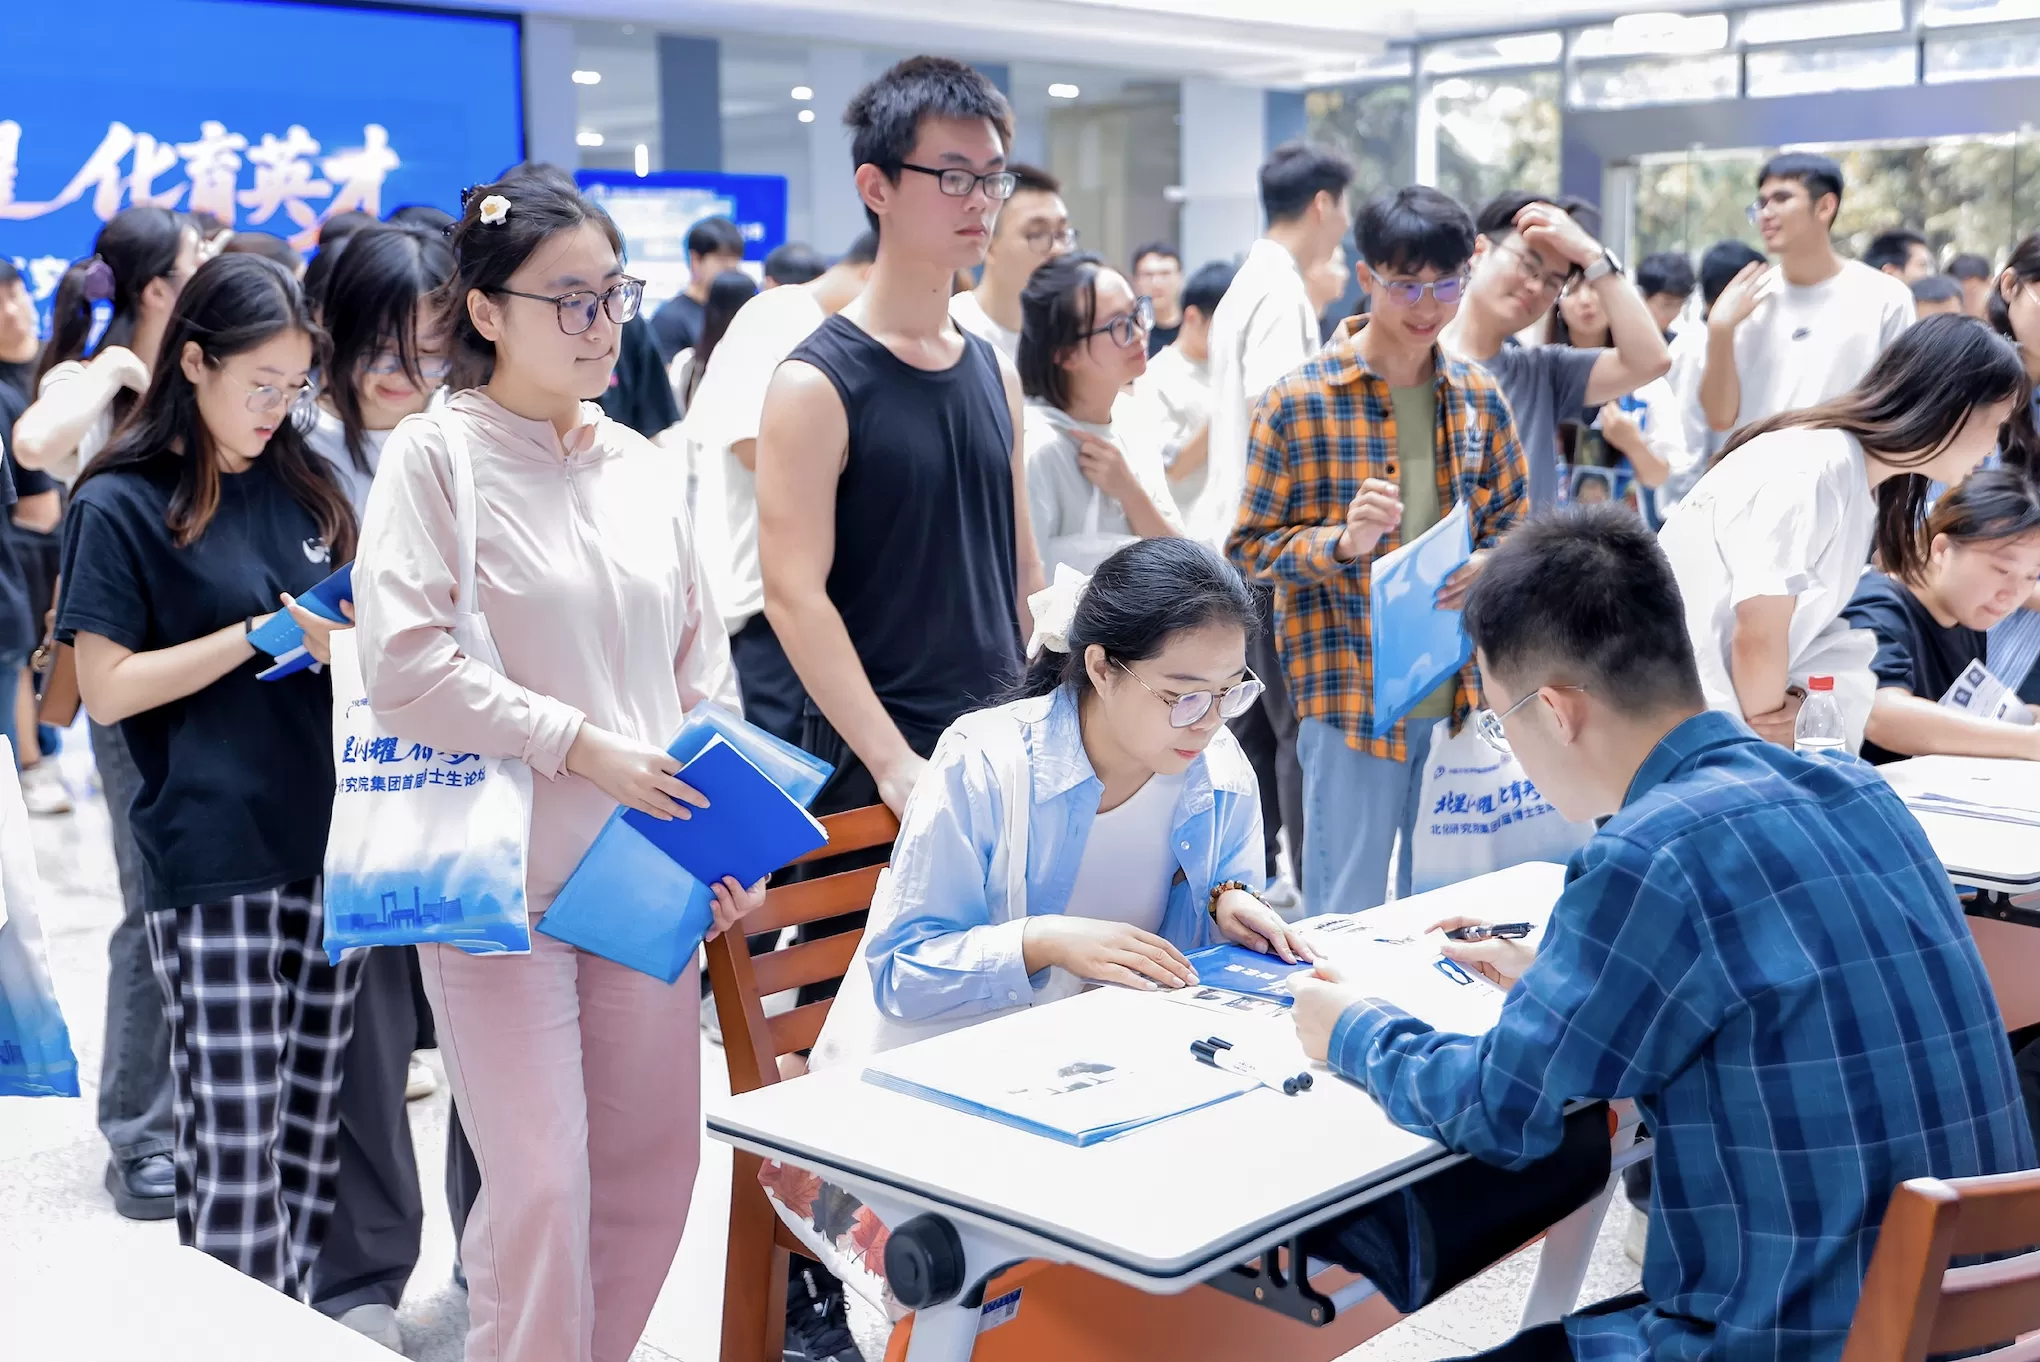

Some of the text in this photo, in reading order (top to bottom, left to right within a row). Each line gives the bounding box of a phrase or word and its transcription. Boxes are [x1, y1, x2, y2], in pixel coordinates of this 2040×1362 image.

[338, 765, 486, 795] 究院集团首届士生论坛
